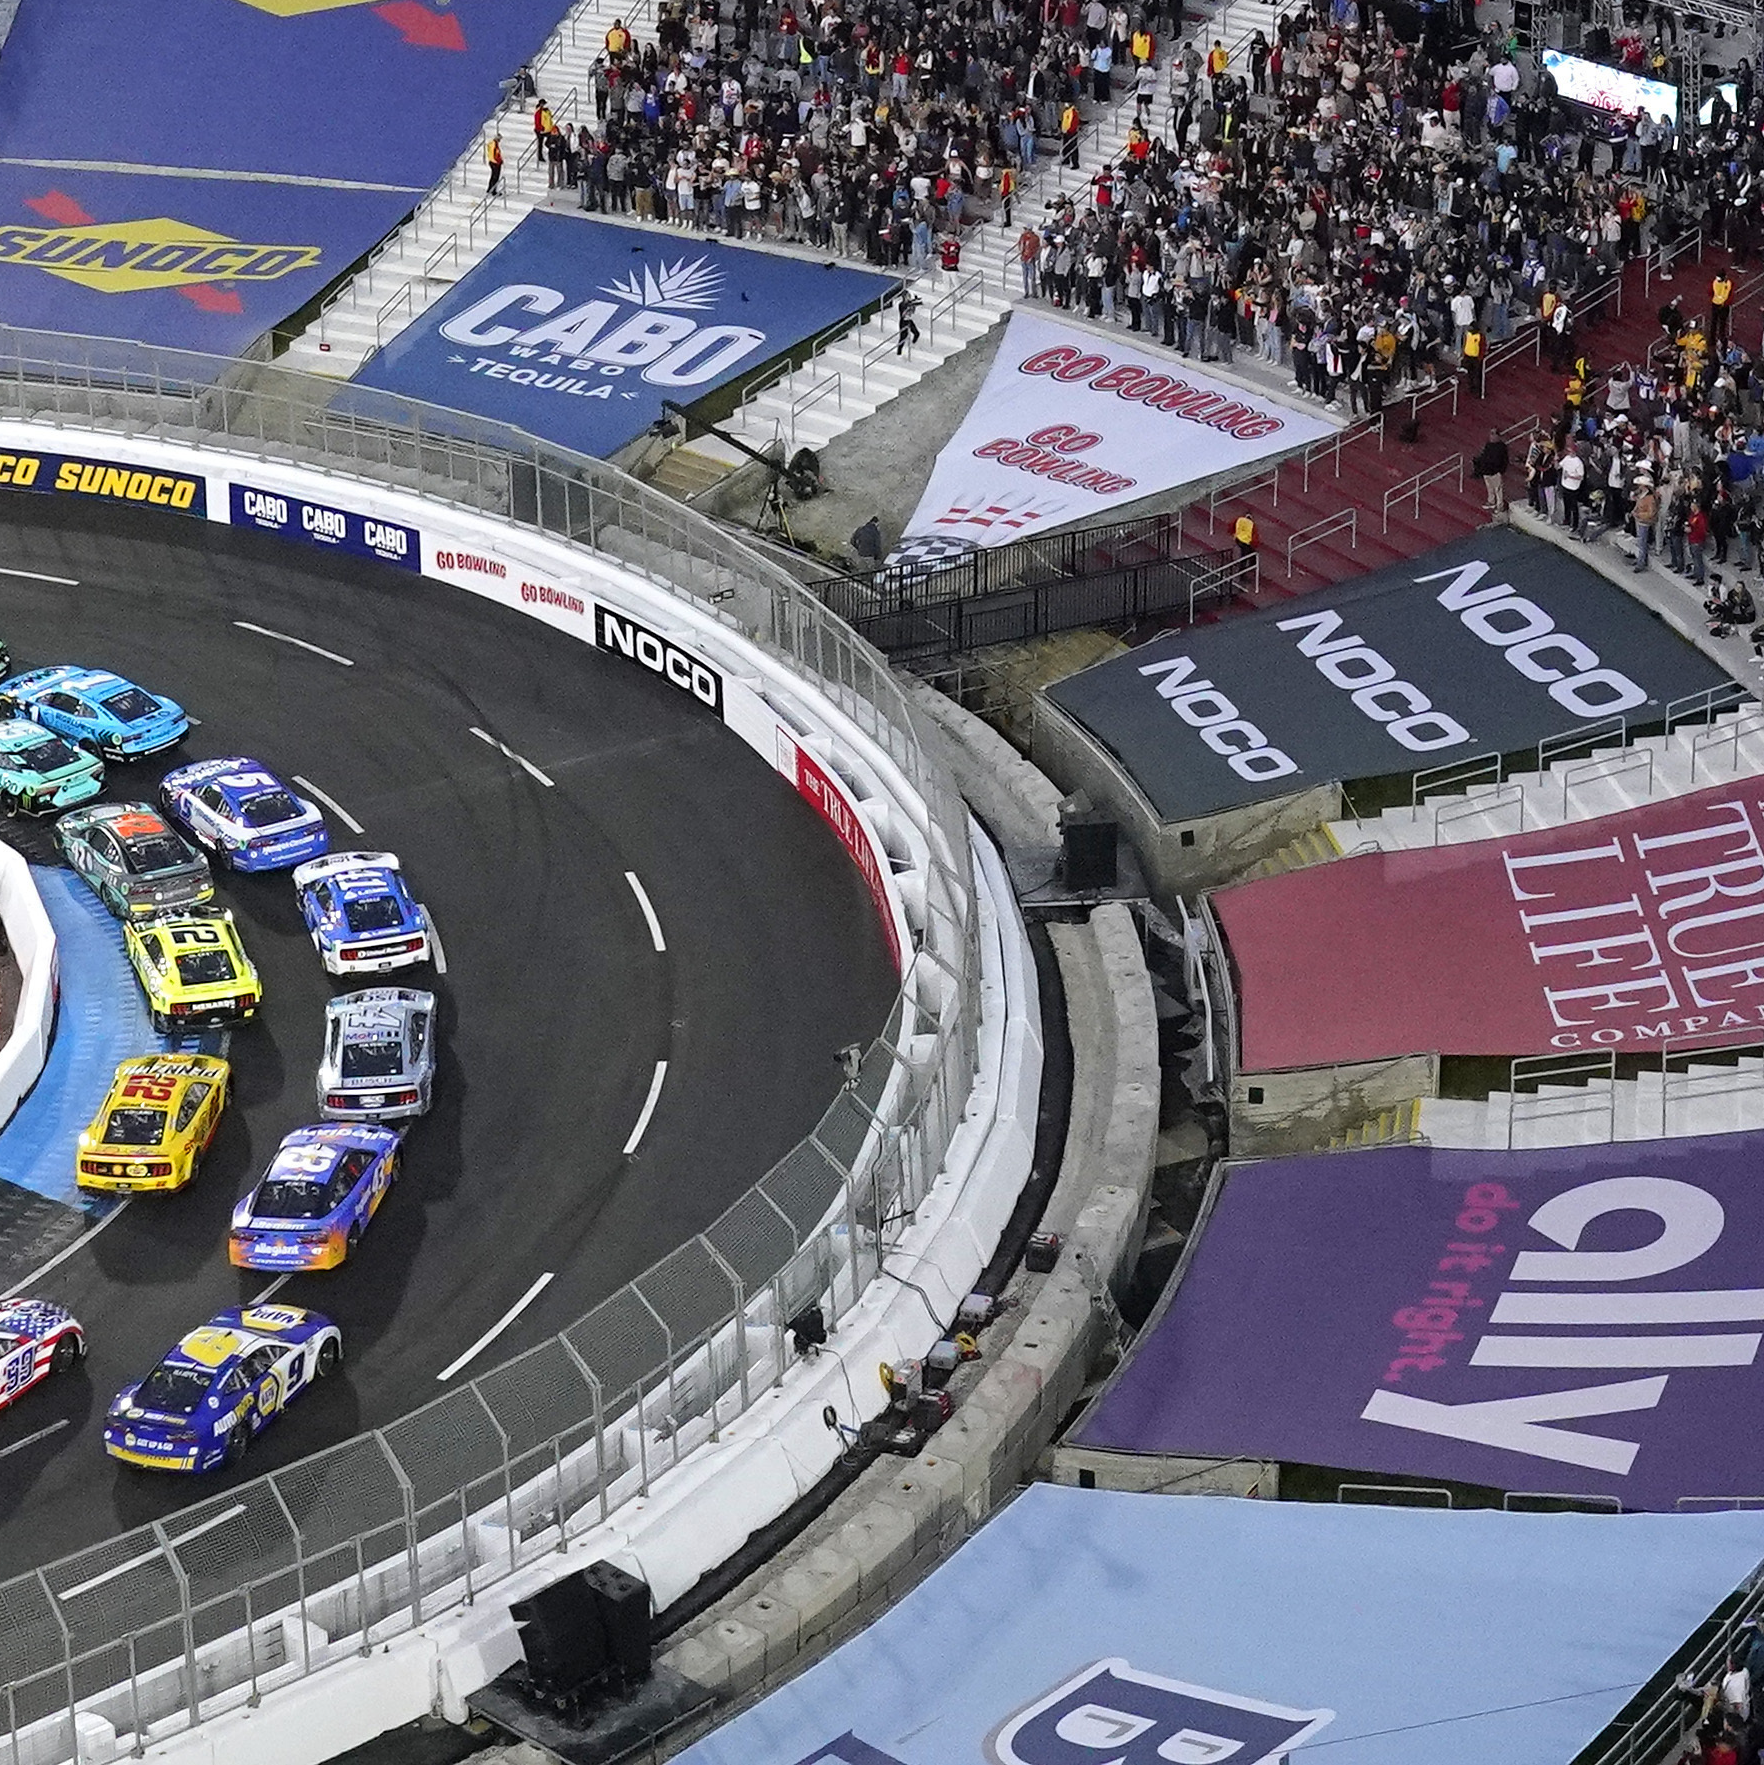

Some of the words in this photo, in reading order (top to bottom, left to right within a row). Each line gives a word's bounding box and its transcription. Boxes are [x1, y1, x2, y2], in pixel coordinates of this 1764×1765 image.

[437, 283, 766, 388] CABO
[467, 356, 617, 401] TEQUILA
[510, 343, 629, 378] WABO
[1019, 345, 1111, 383] GO
[1088, 363, 1285, 440] BOWLING
[1027, 422, 1104, 455] GO
[54, 460, 197, 510] SUNOCO
[972, 437, 1138, 495] BOWLING
[243, 491, 288, 524] CABO
[302, 505, 346, 538] CABO
[364, 521, 407, 555] CABO
[437, 551, 455, 570] GO
[457, 553, 507, 579] BOWLING
[521, 582, 537, 602] GO
[539, 586, 585, 614] BOWLING
[601, 612, 720, 709] NOCO
[1412, 559, 1648, 718] NOCO
[1275, 609, 1470, 753] NOCO
[1138, 655, 1299, 783] NOCO
[822, 779, 855, 840] TRUE
[1501, 835, 1680, 1028] LIFE
[192, 1000, 236, 1011] MENARDS
[122, 1074, 177, 1100] 22
[1457, 1182, 1522, 1233] do
[1437, 1244, 1505, 1273] it
[250, 1308, 298, 1323] NAPA
[1384, 1280, 1484, 1382] right.
[5, 1346, 34, 1396] 99
[289, 1352, 305, 1386] 9
[213, 1411, 237, 1437] AUTO
